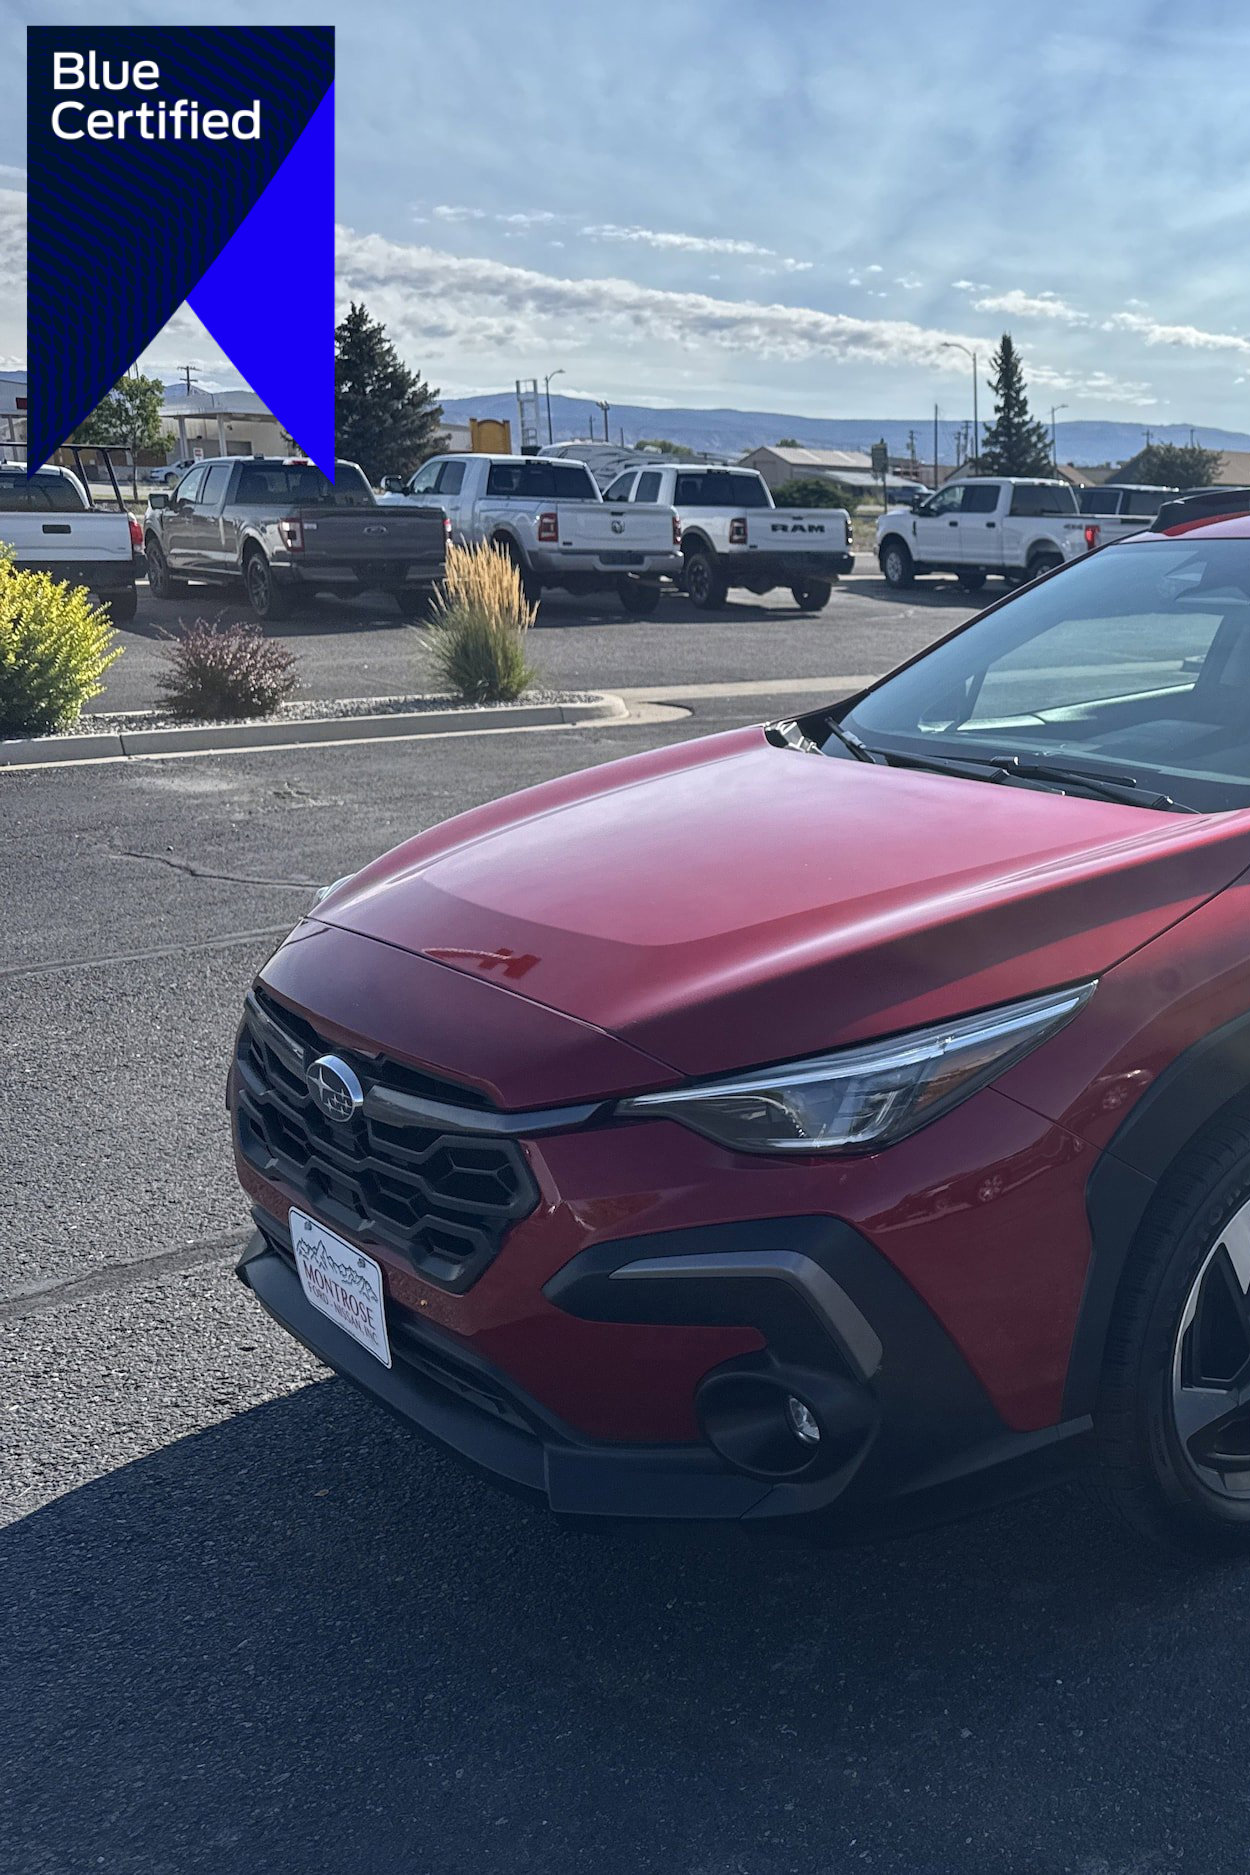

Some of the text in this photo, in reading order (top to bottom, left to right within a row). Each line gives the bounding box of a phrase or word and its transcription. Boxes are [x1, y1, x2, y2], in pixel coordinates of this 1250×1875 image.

[771, 523, 825, 533] RAM
[302, 1259, 376, 1331] MONTROSE
[307, 1280, 329, 1306] FORD
